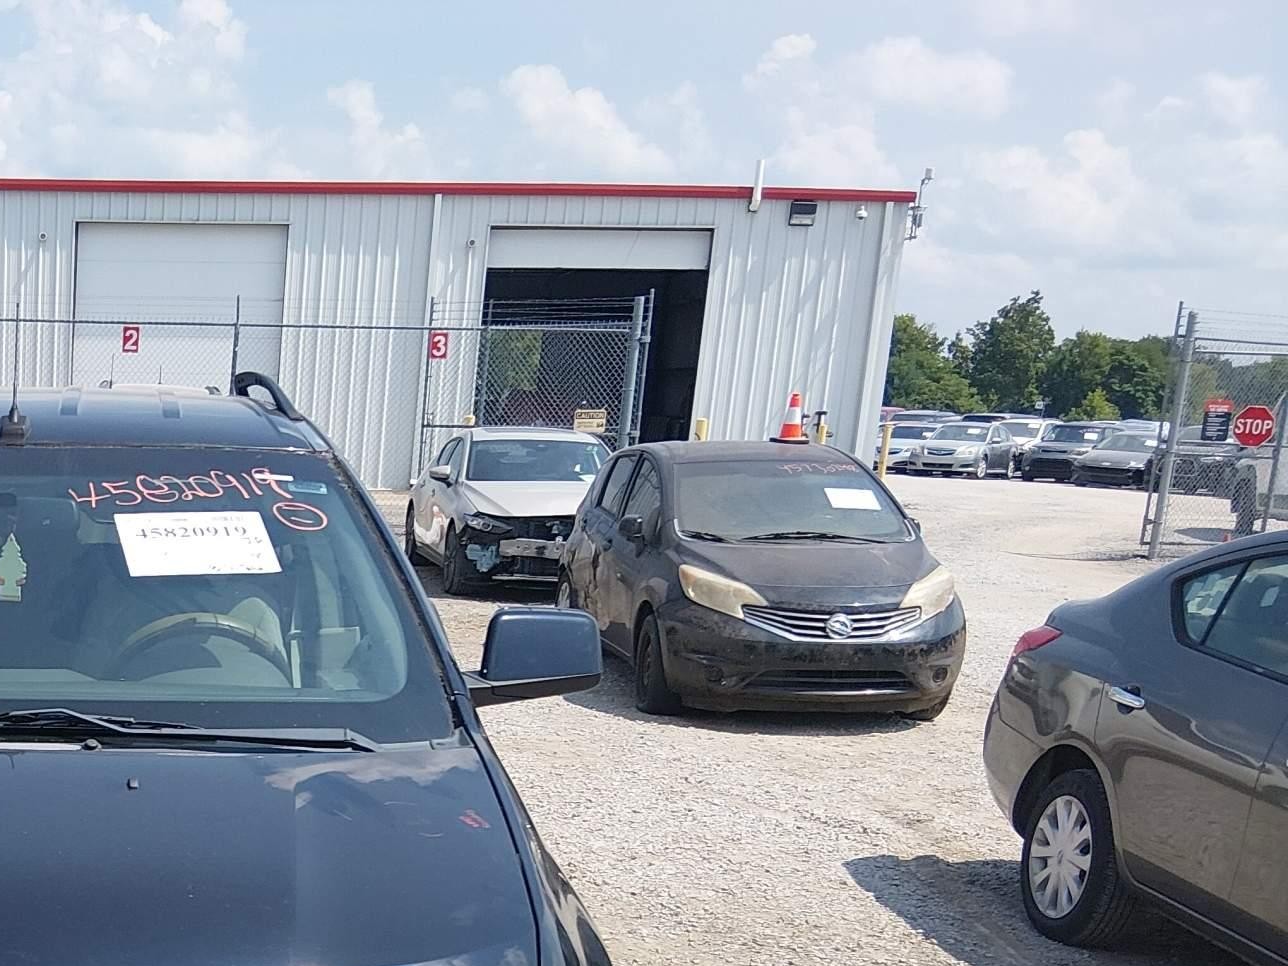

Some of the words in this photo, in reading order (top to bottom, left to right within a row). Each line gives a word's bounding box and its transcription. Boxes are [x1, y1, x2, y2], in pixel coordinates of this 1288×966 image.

[124, 329, 138, 350] 2
[432, 335, 446, 357] 3
[1235, 419, 1272, 435] STOP
[68, 467, 294, 508] 45820919
[136, 526, 247, 539] 45820919
